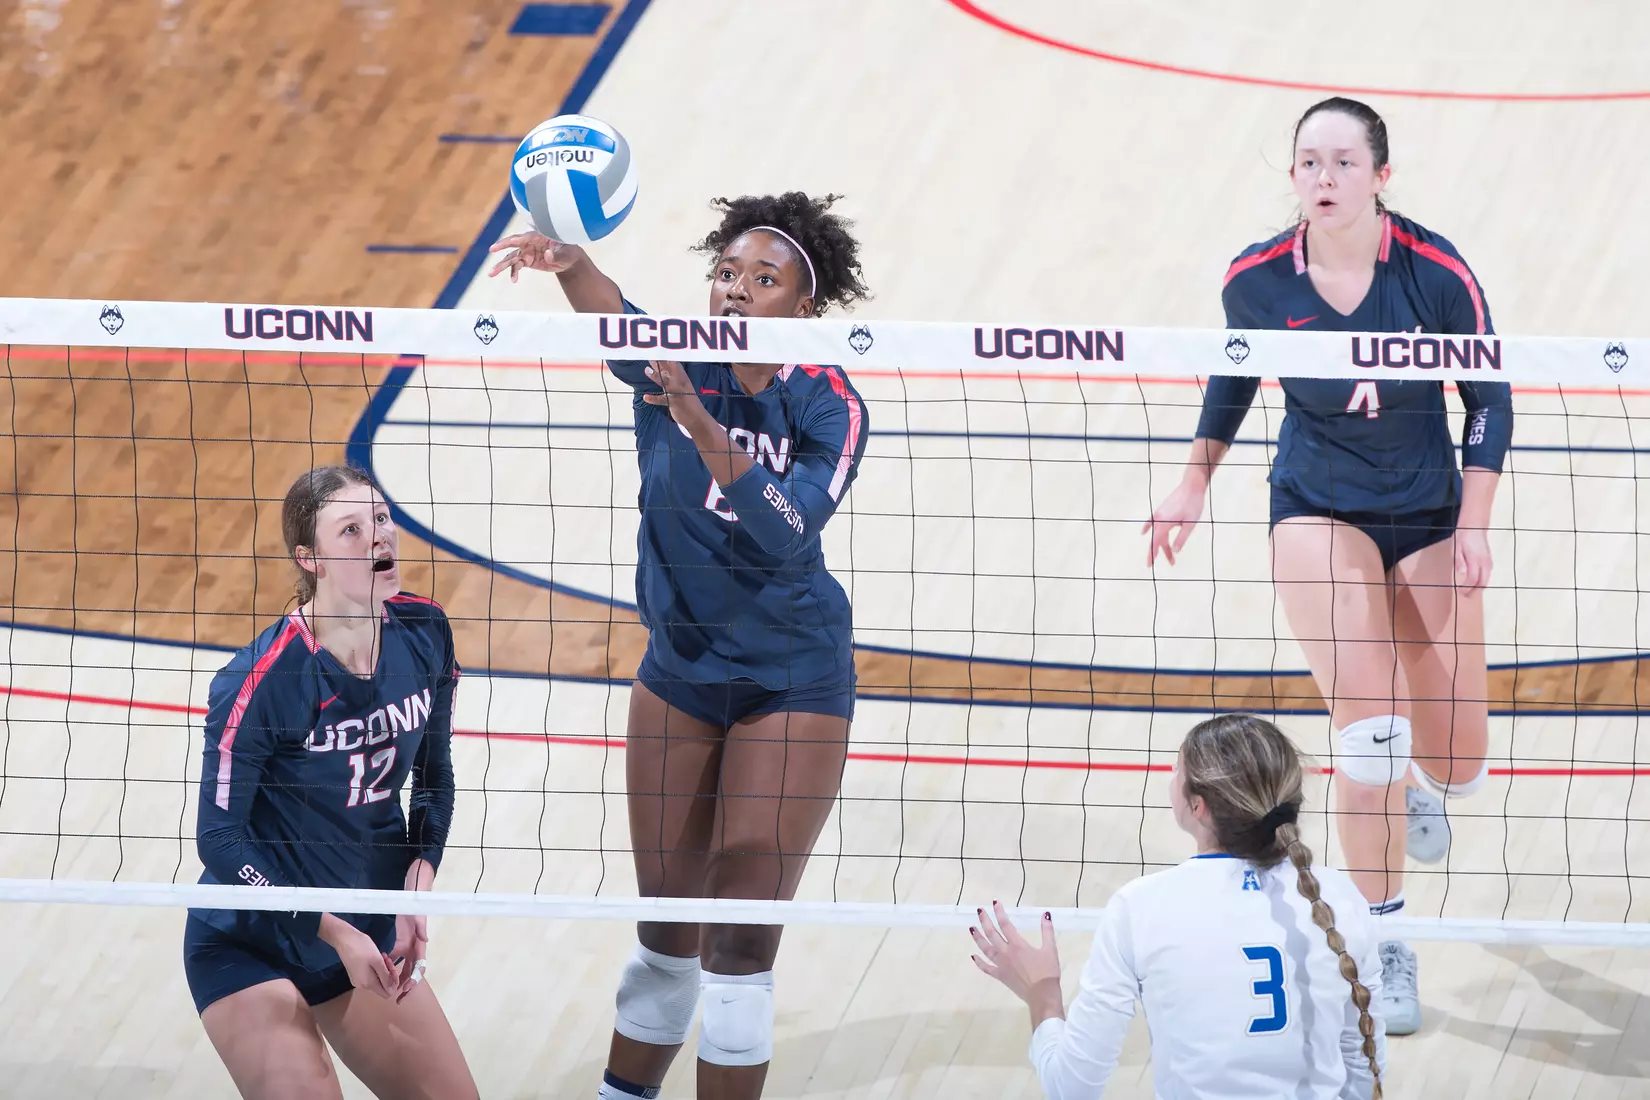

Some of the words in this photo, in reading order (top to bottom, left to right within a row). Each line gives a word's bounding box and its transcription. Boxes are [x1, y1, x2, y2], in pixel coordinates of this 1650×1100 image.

[526, 149, 594, 168] molten
[225, 307, 373, 342] UCONN
[599, 317, 748, 350] UCONN
[974, 327, 1124, 361] UCONN
[1351, 336, 1501, 370] UCONN
[1345, 381, 1381, 419] 4
[303, 688, 432, 752] UCONN
[346, 746, 396, 808] 12
[1240, 943, 1288, 1036] 3
